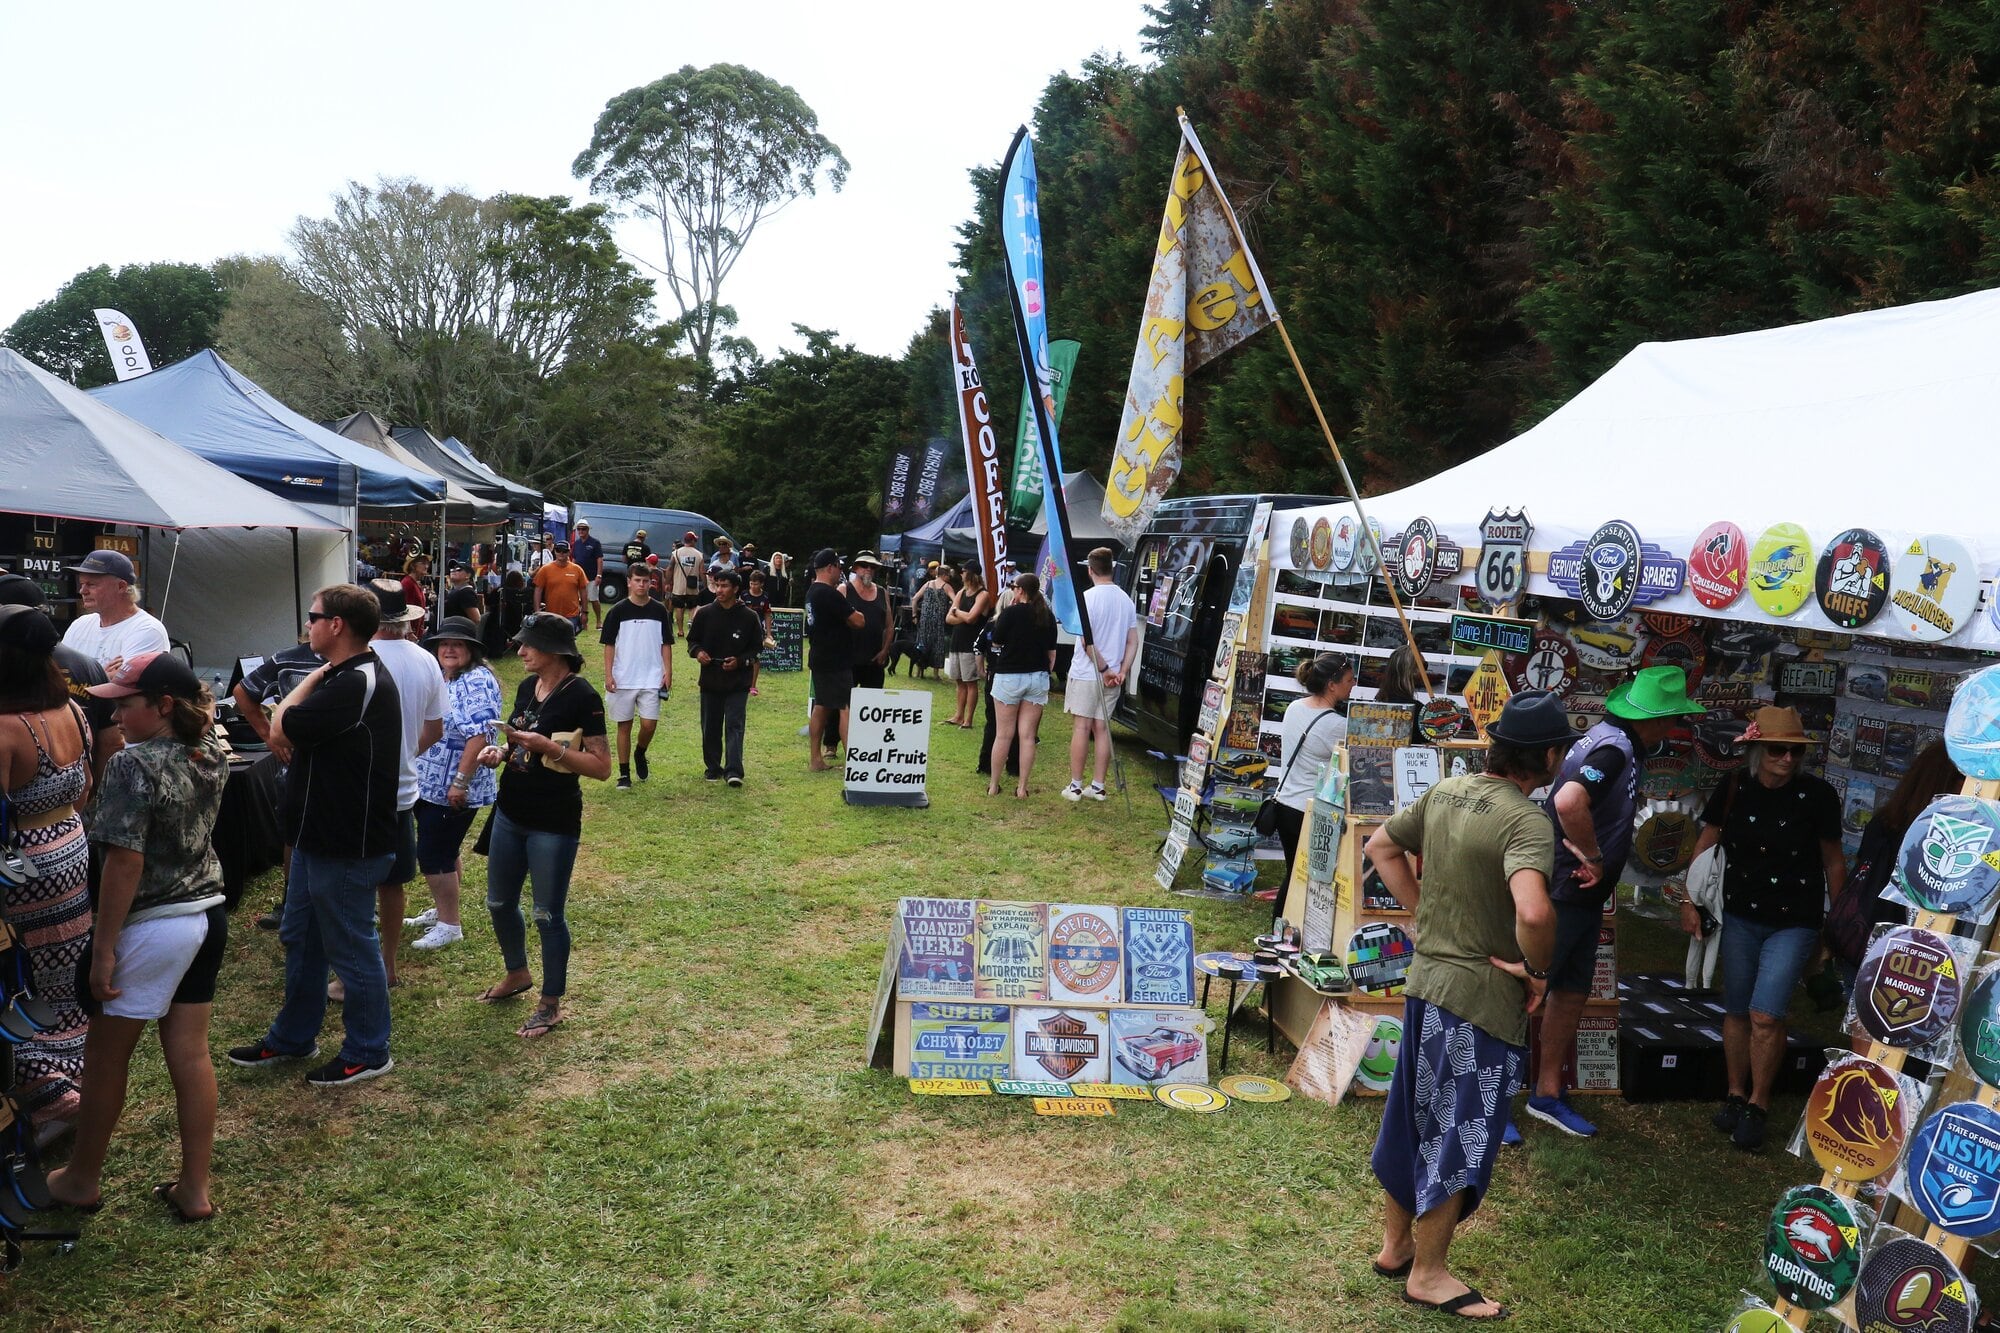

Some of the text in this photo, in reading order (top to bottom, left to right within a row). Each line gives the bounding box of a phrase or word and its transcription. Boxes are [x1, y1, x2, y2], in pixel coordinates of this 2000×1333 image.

[890, 481, 906, 498] BBQ
[917, 478, 936, 496] BBQ
[972, 390, 1007, 597] COFFEE
[1406, 523, 1432, 542] HOLDEN
[1486, 526, 1523, 540] ROUTE
[1586, 527, 1636, 559] SALES SERVICE
[23, 558, 61, 573] DAVE
[1437, 550, 1459, 569] SPARES
[1597, 548, 1618, 565] Ford
[1416, 557, 1432, 593] PARTS
[1485, 550, 1516, 592] 66
[1641, 566, 1677, 588] SPARES
[1581, 563, 1636, 616] AUTHORISED DEALER
[1692, 575, 1732, 598] CRUSADERS
[1824, 592, 1869, 619] CHIEFS
[1892, 589, 1954, 634] HIGHLANDERS
[1651, 614, 1688, 632] CYCLES
[1533, 639, 1569, 658] ORD
[1479, 677, 1497, 691] MAN
[1889, 671, 1932, 686] Ferrari
[1705, 679, 1747, 698] Dad's
[1474, 691, 1499, 712] CAVE
[1565, 696, 1606, 712] Indian
[859, 706, 922, 724] COFFEE
[1862, 718, 1885, 729] BLEED
[883, 728, 895, 742] &
[1228, 740, 1258, 750] FICTION
[1855, 743, 1881, 756] HOUSE
[847, 748, 927, 765] Real Fruit
[845, 767, 926, 784] Ice Cream
[1917, 862, 1968, 892] WARRIORS
[906, 900, 971, 919] NO TOOLS
[990, 909, 1017, 917] MONEY
[1126, 909, 1187, 922] GENUINE
[909, 920, 967, 937] LOANED
[992, 922, 1030, 931] EXPLAIN
[1056, 916, 1113, 945] SPEIGHT'S
[1140, 922, 1179, 934] PARTS
[911, 936, 965, 956] HERE
[1155, 934, 1163, 943] &
[1893, 943, 1939, 962] STATE OF ORIGIN
[977, 965, 1044, 978] MOTORCYCLES
[1058, 961, 1112, 987] GOLD MEDAL ALE
[1144, 964, 1173, 977] Ford
[1888, 953, 1932, 982] QLD
[995, 984, 1026, 998] BEER
[1884, 976, 1926, 997] MAROONS
[1133, 991, 1187, 1003] SERVICE
[927, 1005, 994, 1020] SUPER
[1045, 1021, 1081, 1035] MOTOR
[1579, 1019, 1615, 1029] WARNING
[920, 1034, 1002, 1050] CHEVROLET
[1030, 1037, 1095, 1054] HARLEY-DAVIDSON
[1045, 1056, 1082, 1076] COMPANY
[1664, 1057, 1675, 1065] 10
[919, 1064, 1003, 1079] SERVICE
[1584, 1079, 1611, 1087] FASTEST
[1947, 1122, 1968, 1137] STATE
[1968, 1130, 1978, 1141] OF
[1812, 1130, 1876, 1168] BRONCOS
[1818, 1142, 1864, 1170] BRISBANE
[1937, 1130, 2000, 1176] NSW
[1946, 1162, 1980, 1185] BLUES
[1800, 1206, 1835, 1227] SOUTH SYDNEY
[1767, 1252, 1836, 1301] RABBITOHS
